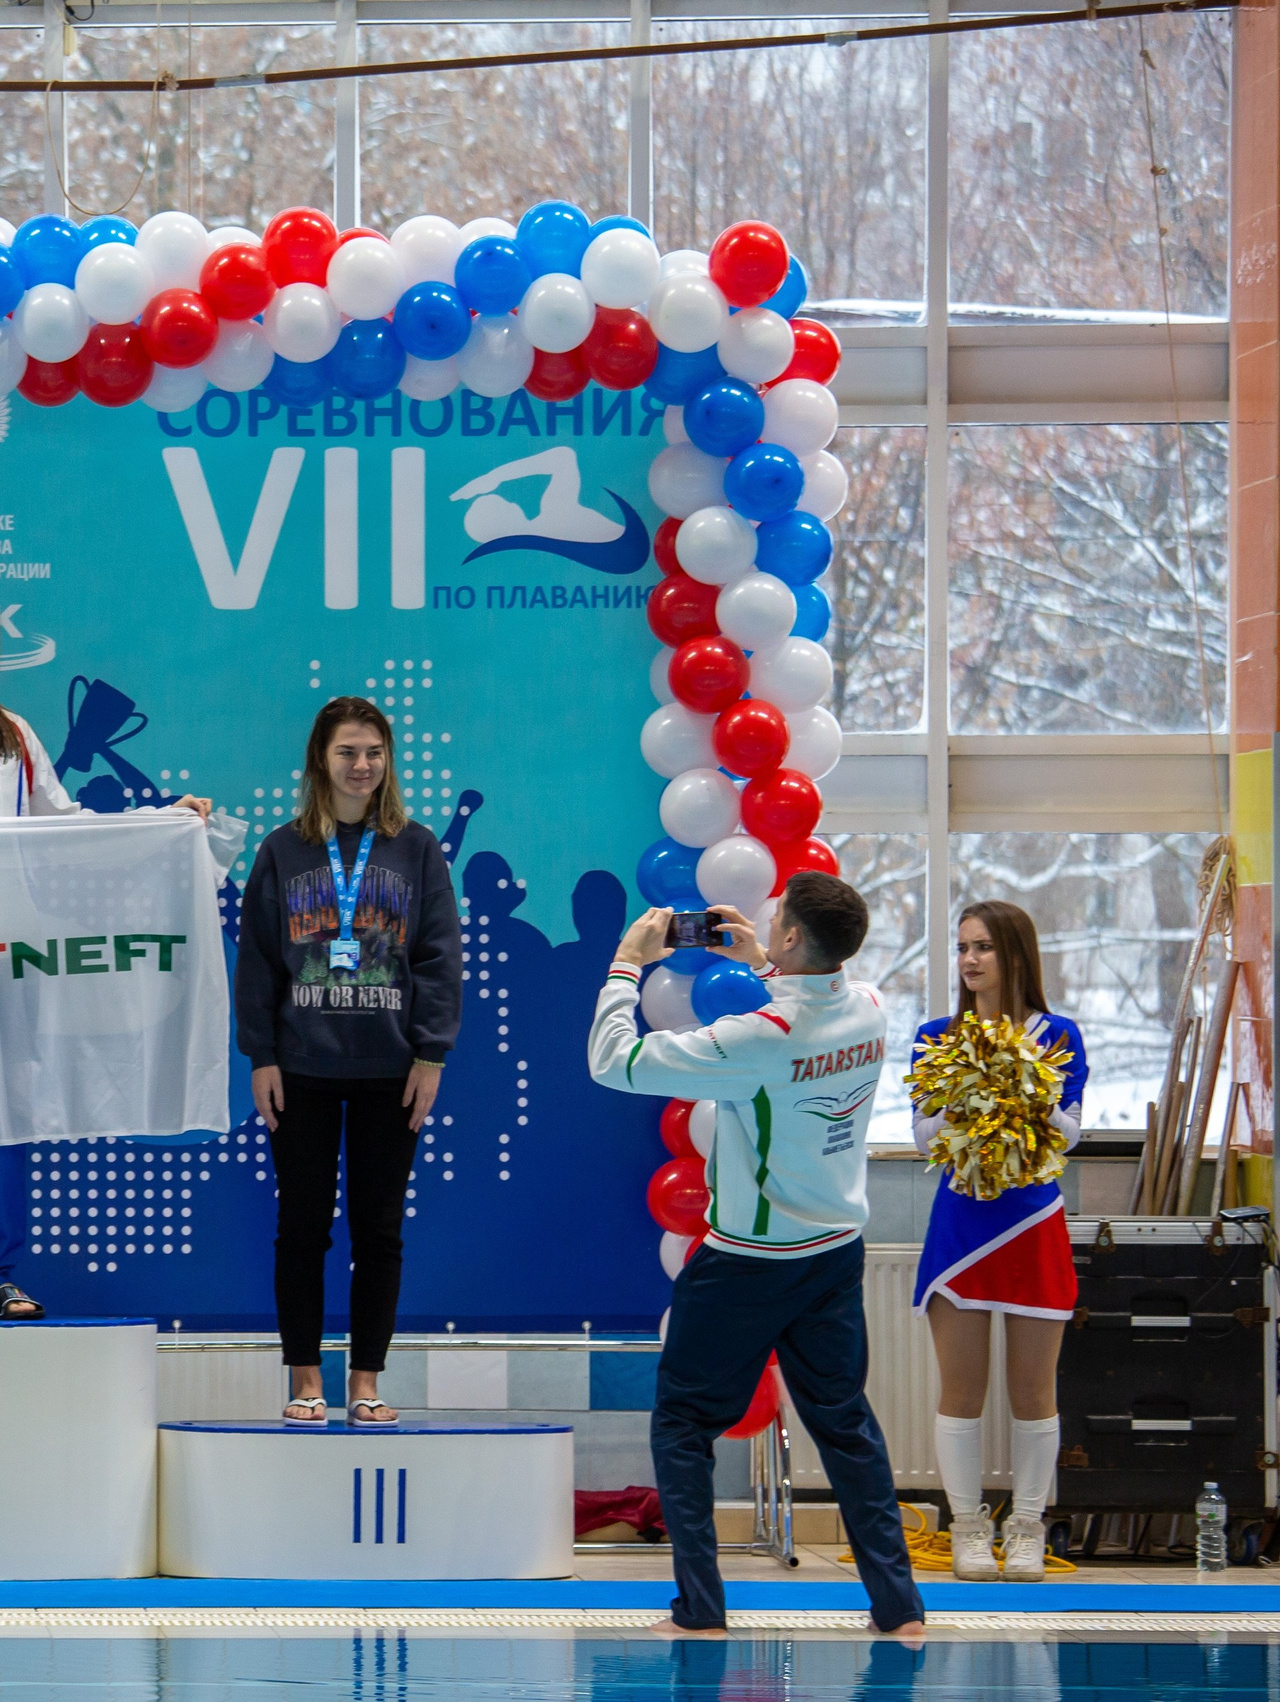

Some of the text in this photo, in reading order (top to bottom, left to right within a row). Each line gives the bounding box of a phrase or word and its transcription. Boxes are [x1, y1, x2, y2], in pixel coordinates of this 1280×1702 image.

[157, 389, 665, 438] СОРЕВНОВАНИЯ
[161, 446, 426, 610] VII
[433, 586, 476, 609] ПО
[291, 985, 325, 1007] NOW
[329, 985, 353, 1008] OR
[790, 1037, 885, 1082] TATARSTAN
